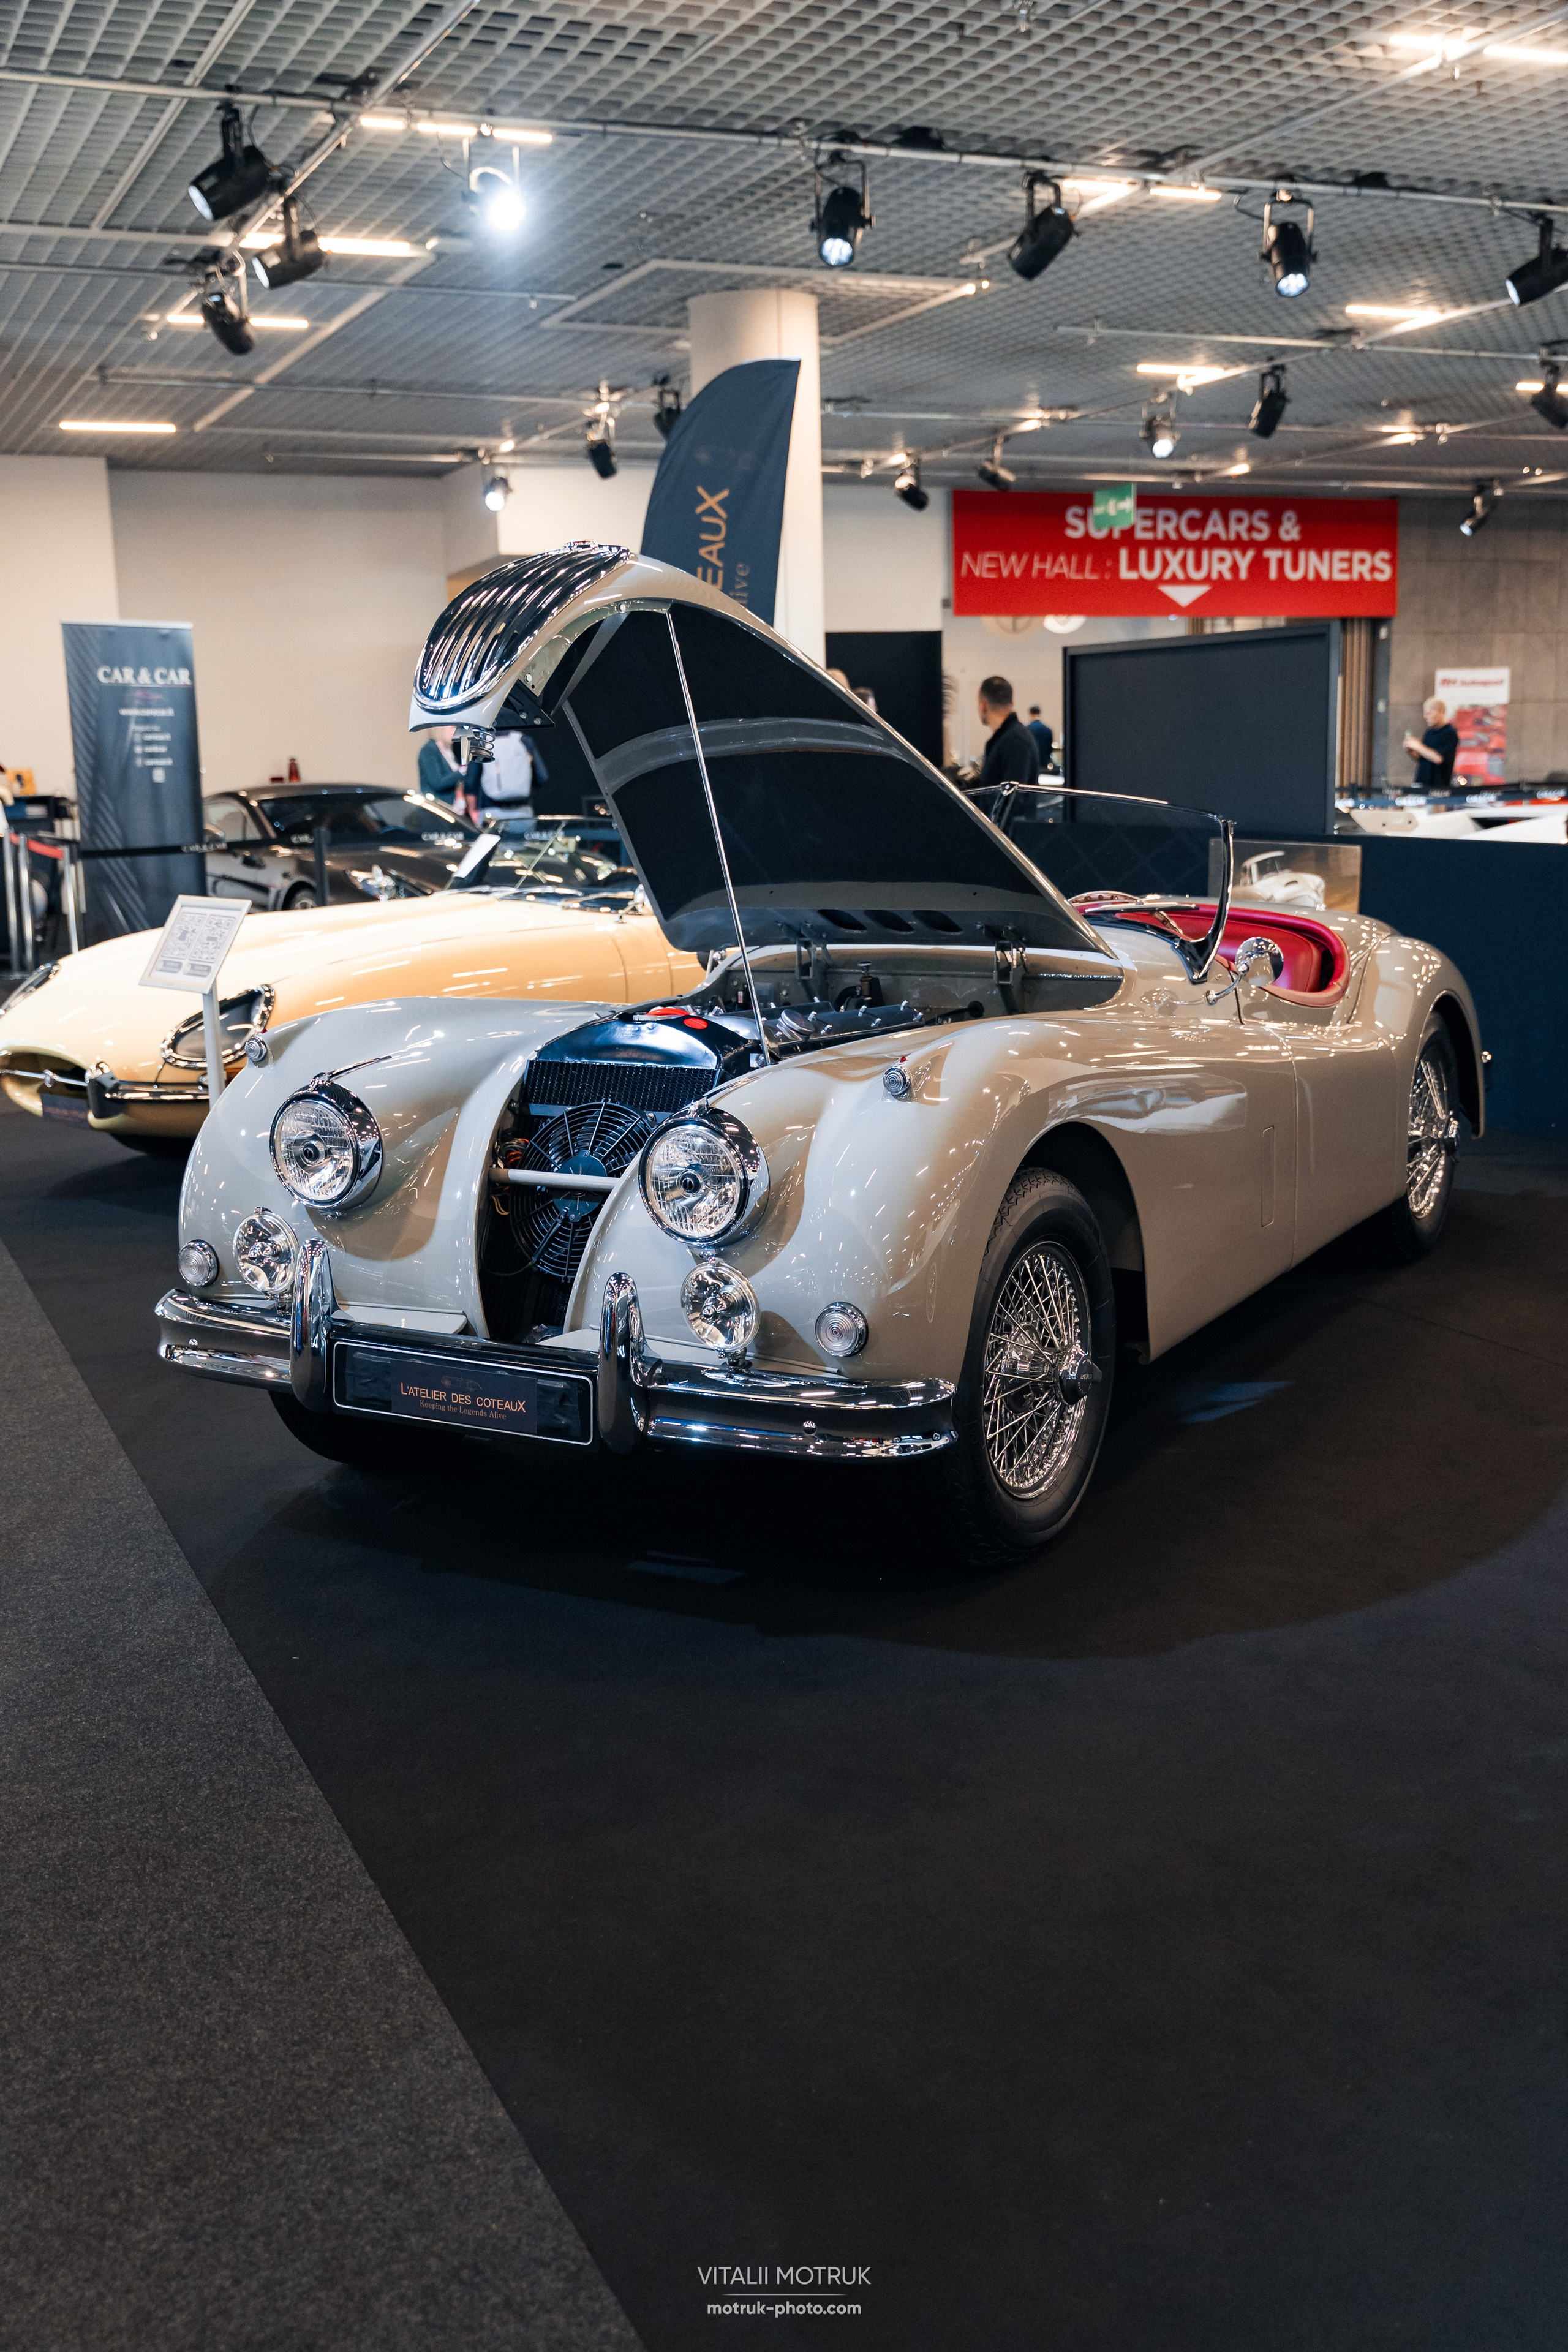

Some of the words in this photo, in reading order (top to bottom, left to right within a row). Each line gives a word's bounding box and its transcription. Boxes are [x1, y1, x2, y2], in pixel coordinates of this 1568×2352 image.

[1278, 509, 1302, 541] &
[961, 552, 1030, 579] NEW
[1031, 552, 1099, 580] HALL
[1119, 548, 1256, 581] LUXURY
[1262, 549, 1393, 582] TUNERS
[97, 665, 135, 684] CAR
[137, 666, 151, 684] &
[154, 666, 191, 685] CAR
[401, 1382, 447, 1401] L'ATELIER
[451, 1393, 472, 1405] DES
[476, 1397, 526, 1413] COTEAUX
[420, 1400, 446, 1412] Keeping
[459, 1406, 488, 1418] Legends
[489, 1411, 507, 1420] Alive
